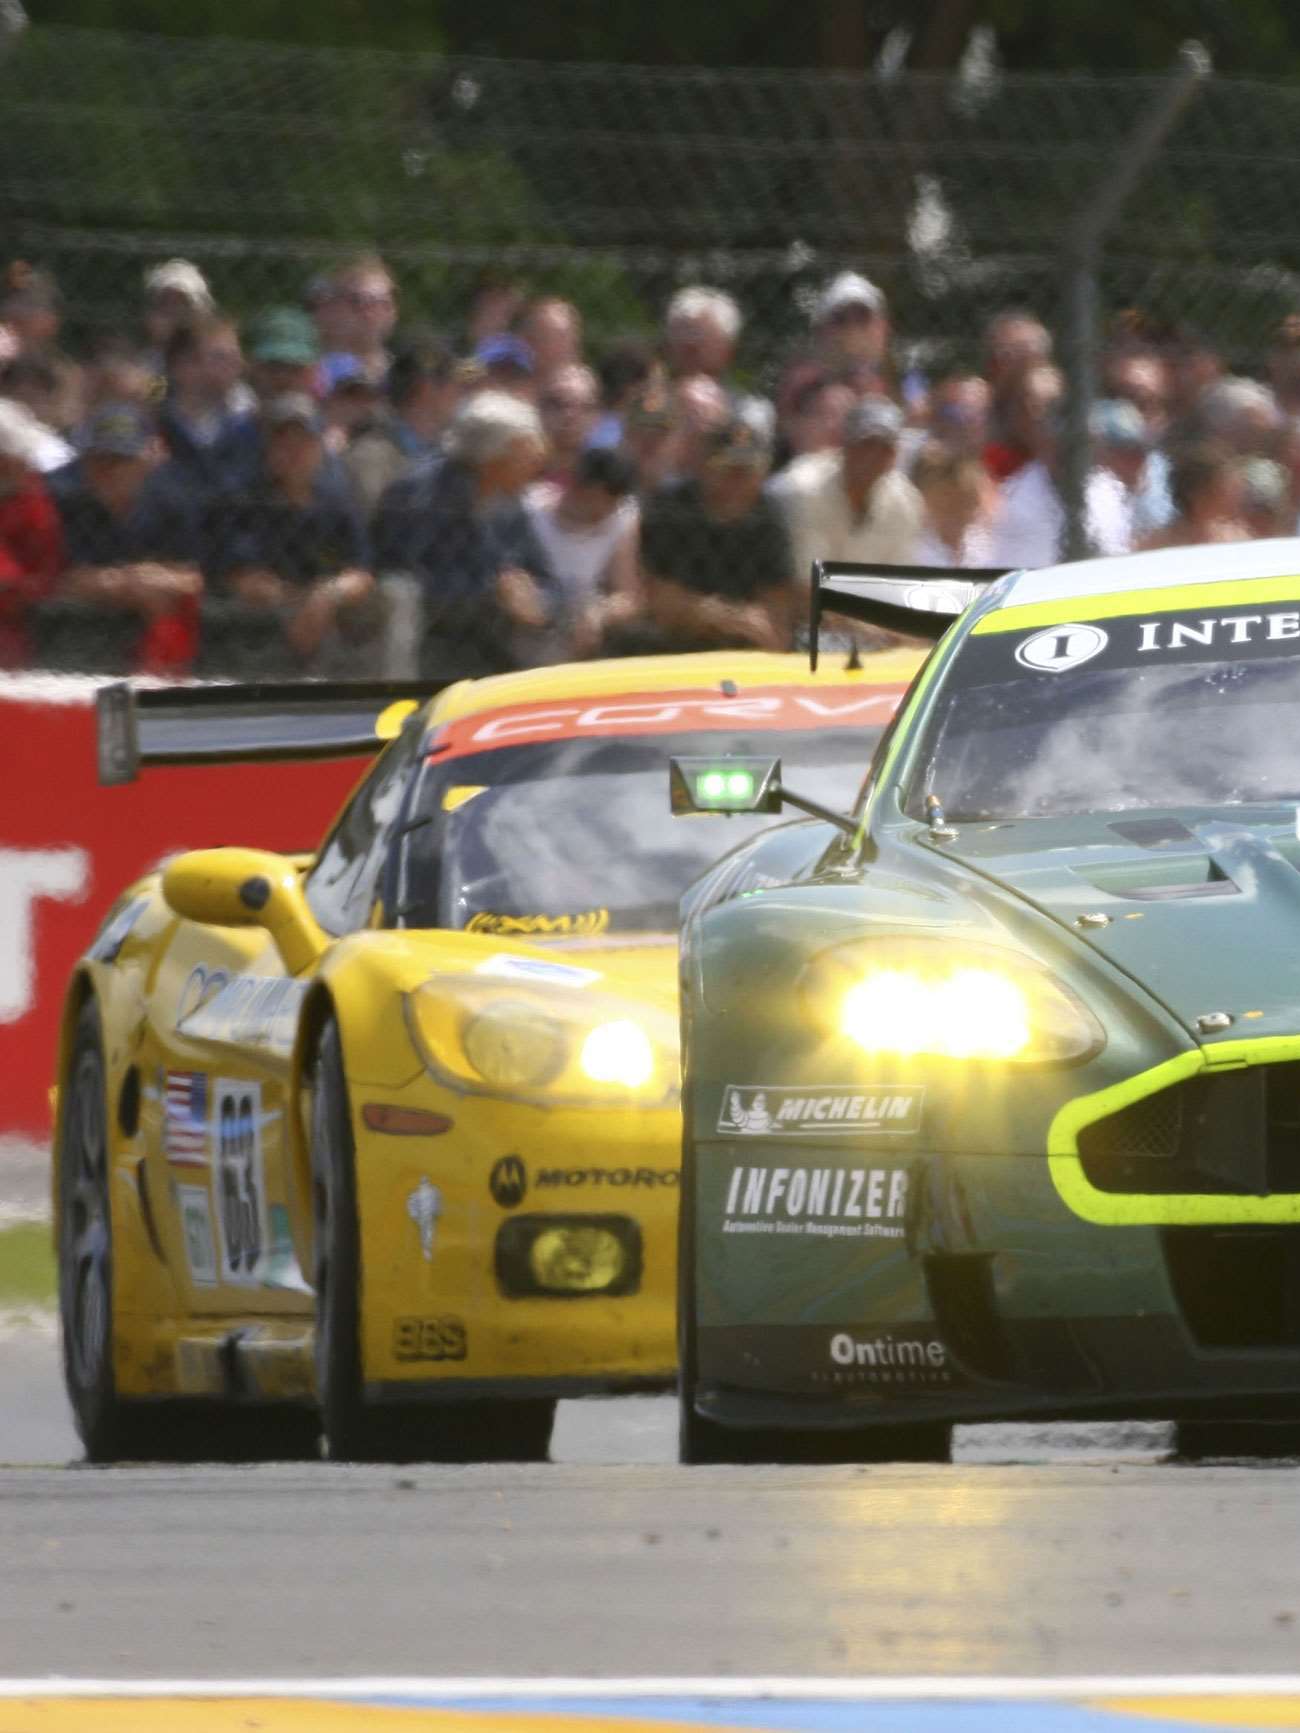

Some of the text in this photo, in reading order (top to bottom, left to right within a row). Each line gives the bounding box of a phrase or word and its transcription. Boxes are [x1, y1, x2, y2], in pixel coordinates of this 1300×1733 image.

[776, 1096, 913, 1120] MICHELIN
[726, 1167, 907, 1217] INFONIZER
[830, 1333, 945, 1366] Ontime
